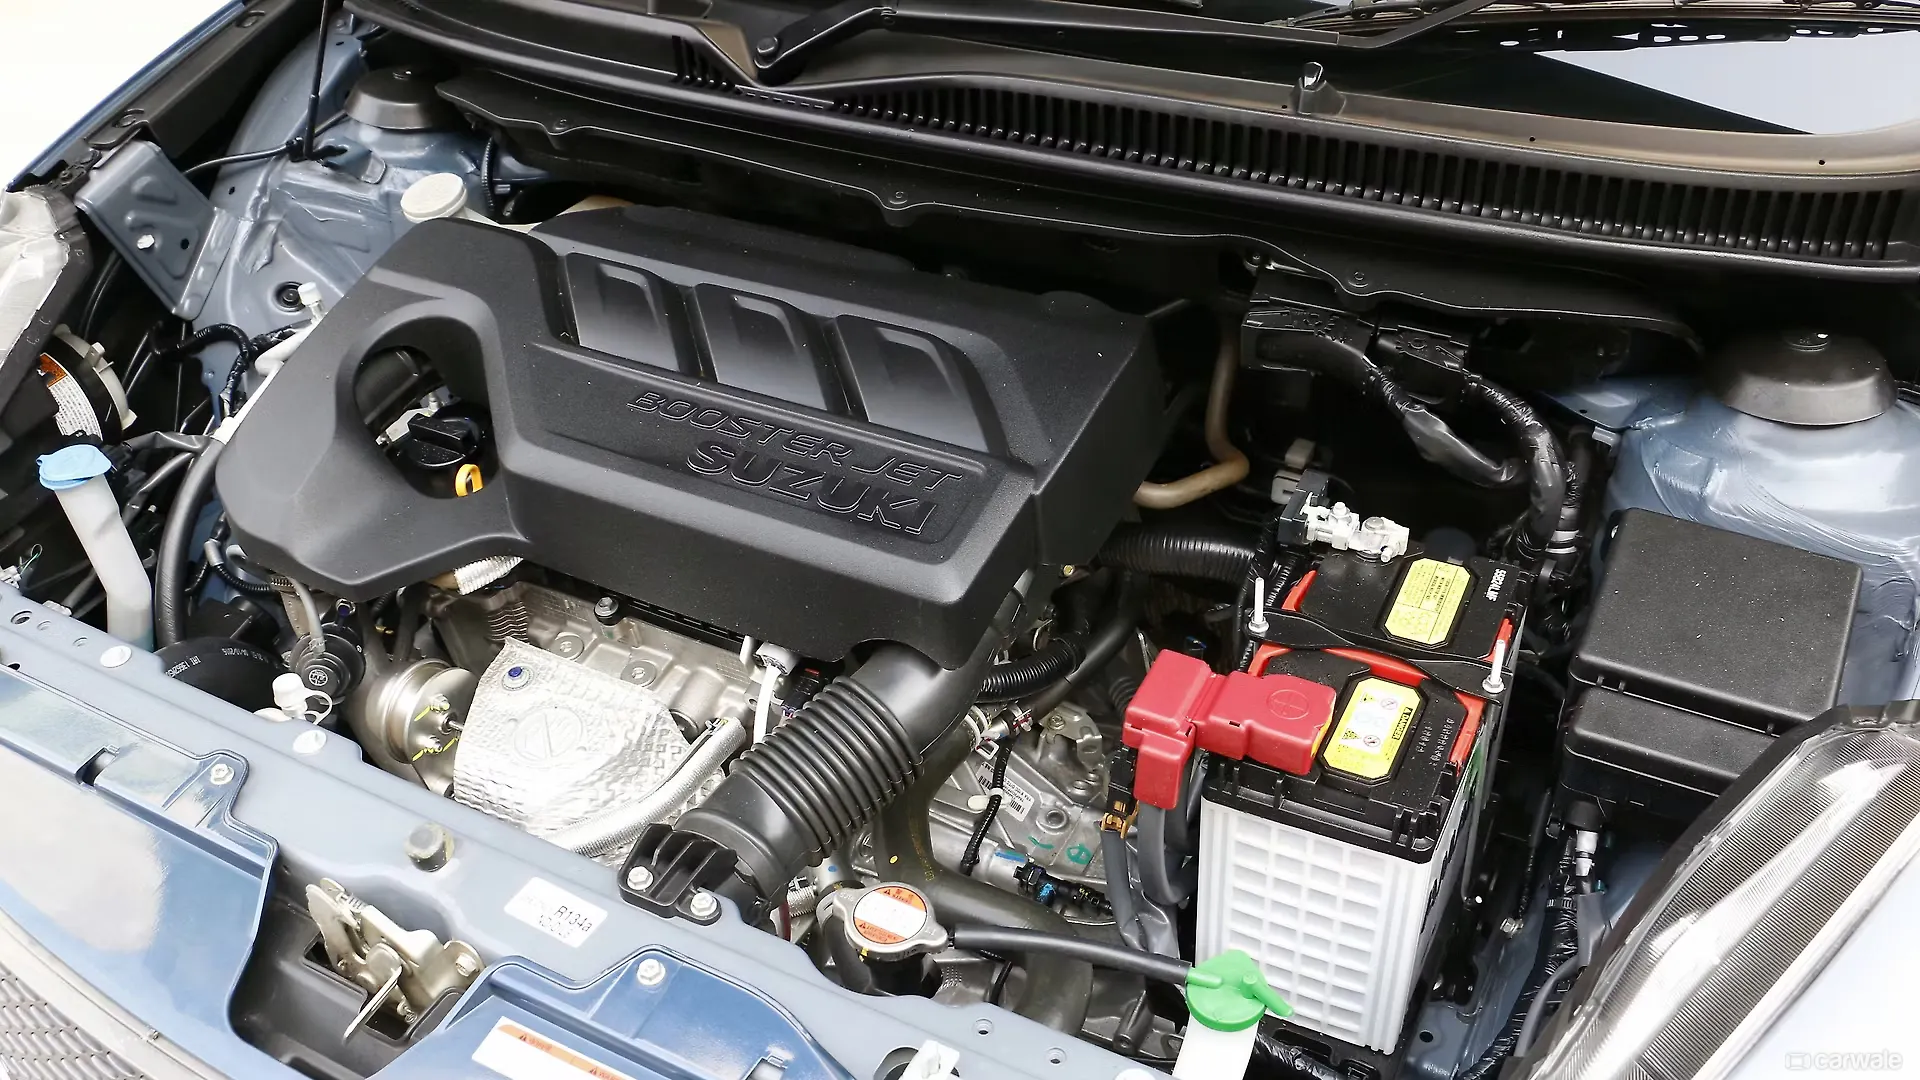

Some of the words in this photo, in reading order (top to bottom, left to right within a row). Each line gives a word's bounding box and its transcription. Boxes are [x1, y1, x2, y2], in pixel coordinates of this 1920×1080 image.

[627, 392, 853, 467] BOOSTER
[850, 457, 964, 492] JET
[686, 440, 939, 536] SUZUKI
[553, 905, 593, 932] R134a
